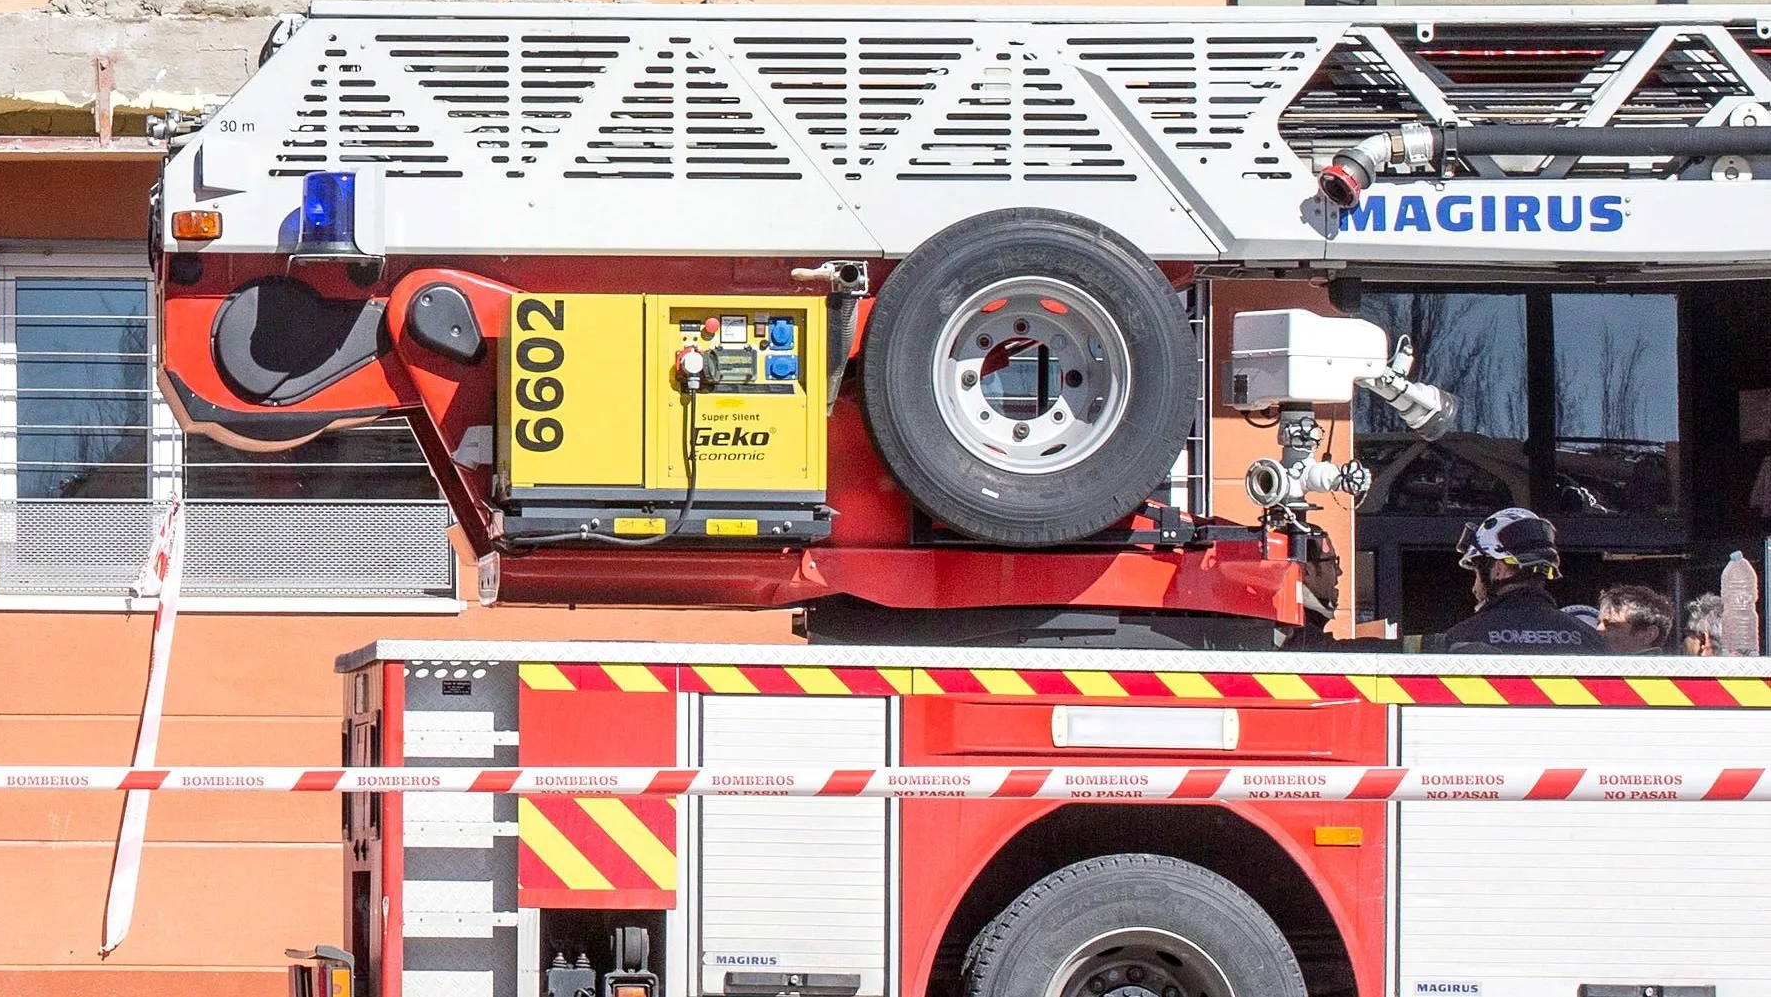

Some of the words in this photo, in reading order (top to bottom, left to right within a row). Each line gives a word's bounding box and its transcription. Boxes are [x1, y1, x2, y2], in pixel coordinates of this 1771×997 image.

[220, 120, 237, 132] 30
[242, 122, 255, 132] m
[1339, 195, 1623, 232] MAGIRUS
[515, 298, 565, 452] 6602
[702, 413, 729, 422] Super
[732, 413, 760, 421] Silent
[1488, 630, 1582, 645] BOMBEROS
[7, 775, 89, 786] BOMBEROS
[182, 776, 264, 787] BOMBEROS
[357, 776, 440, 787] BOMBEROS
[535, 776, 618, 786] BOMBEROS
[712, 776, 795, 786] BOMBEROS
[888, 775, 971, 785] BOMBEROS
[1065, 775, 1148, 785] BOMBEROS
[1243, 775, 1326, 785] BOMBEROS
[1421, 775, 1504, 785] BOMBEROS
[1599, 775, 1682, 785] BOMBEROS
[1070, 790, 1092, 798] NO
[1096, 790, 1142, 798] PASAR
[1248, 791, 1270, 799] NO
[1274, 791, 1321, 799] PASAR
[1426, 791, 1448, 799] NO
[1452, 791, 1499, 799] PASAR
[1604, 791, 1626, 800] NO
[1630, 791, 1677, 800] PASAR
[716, 955, 777, 965] MAGIRUS
[1417, 983, 1479, 993] MAGIRUS
